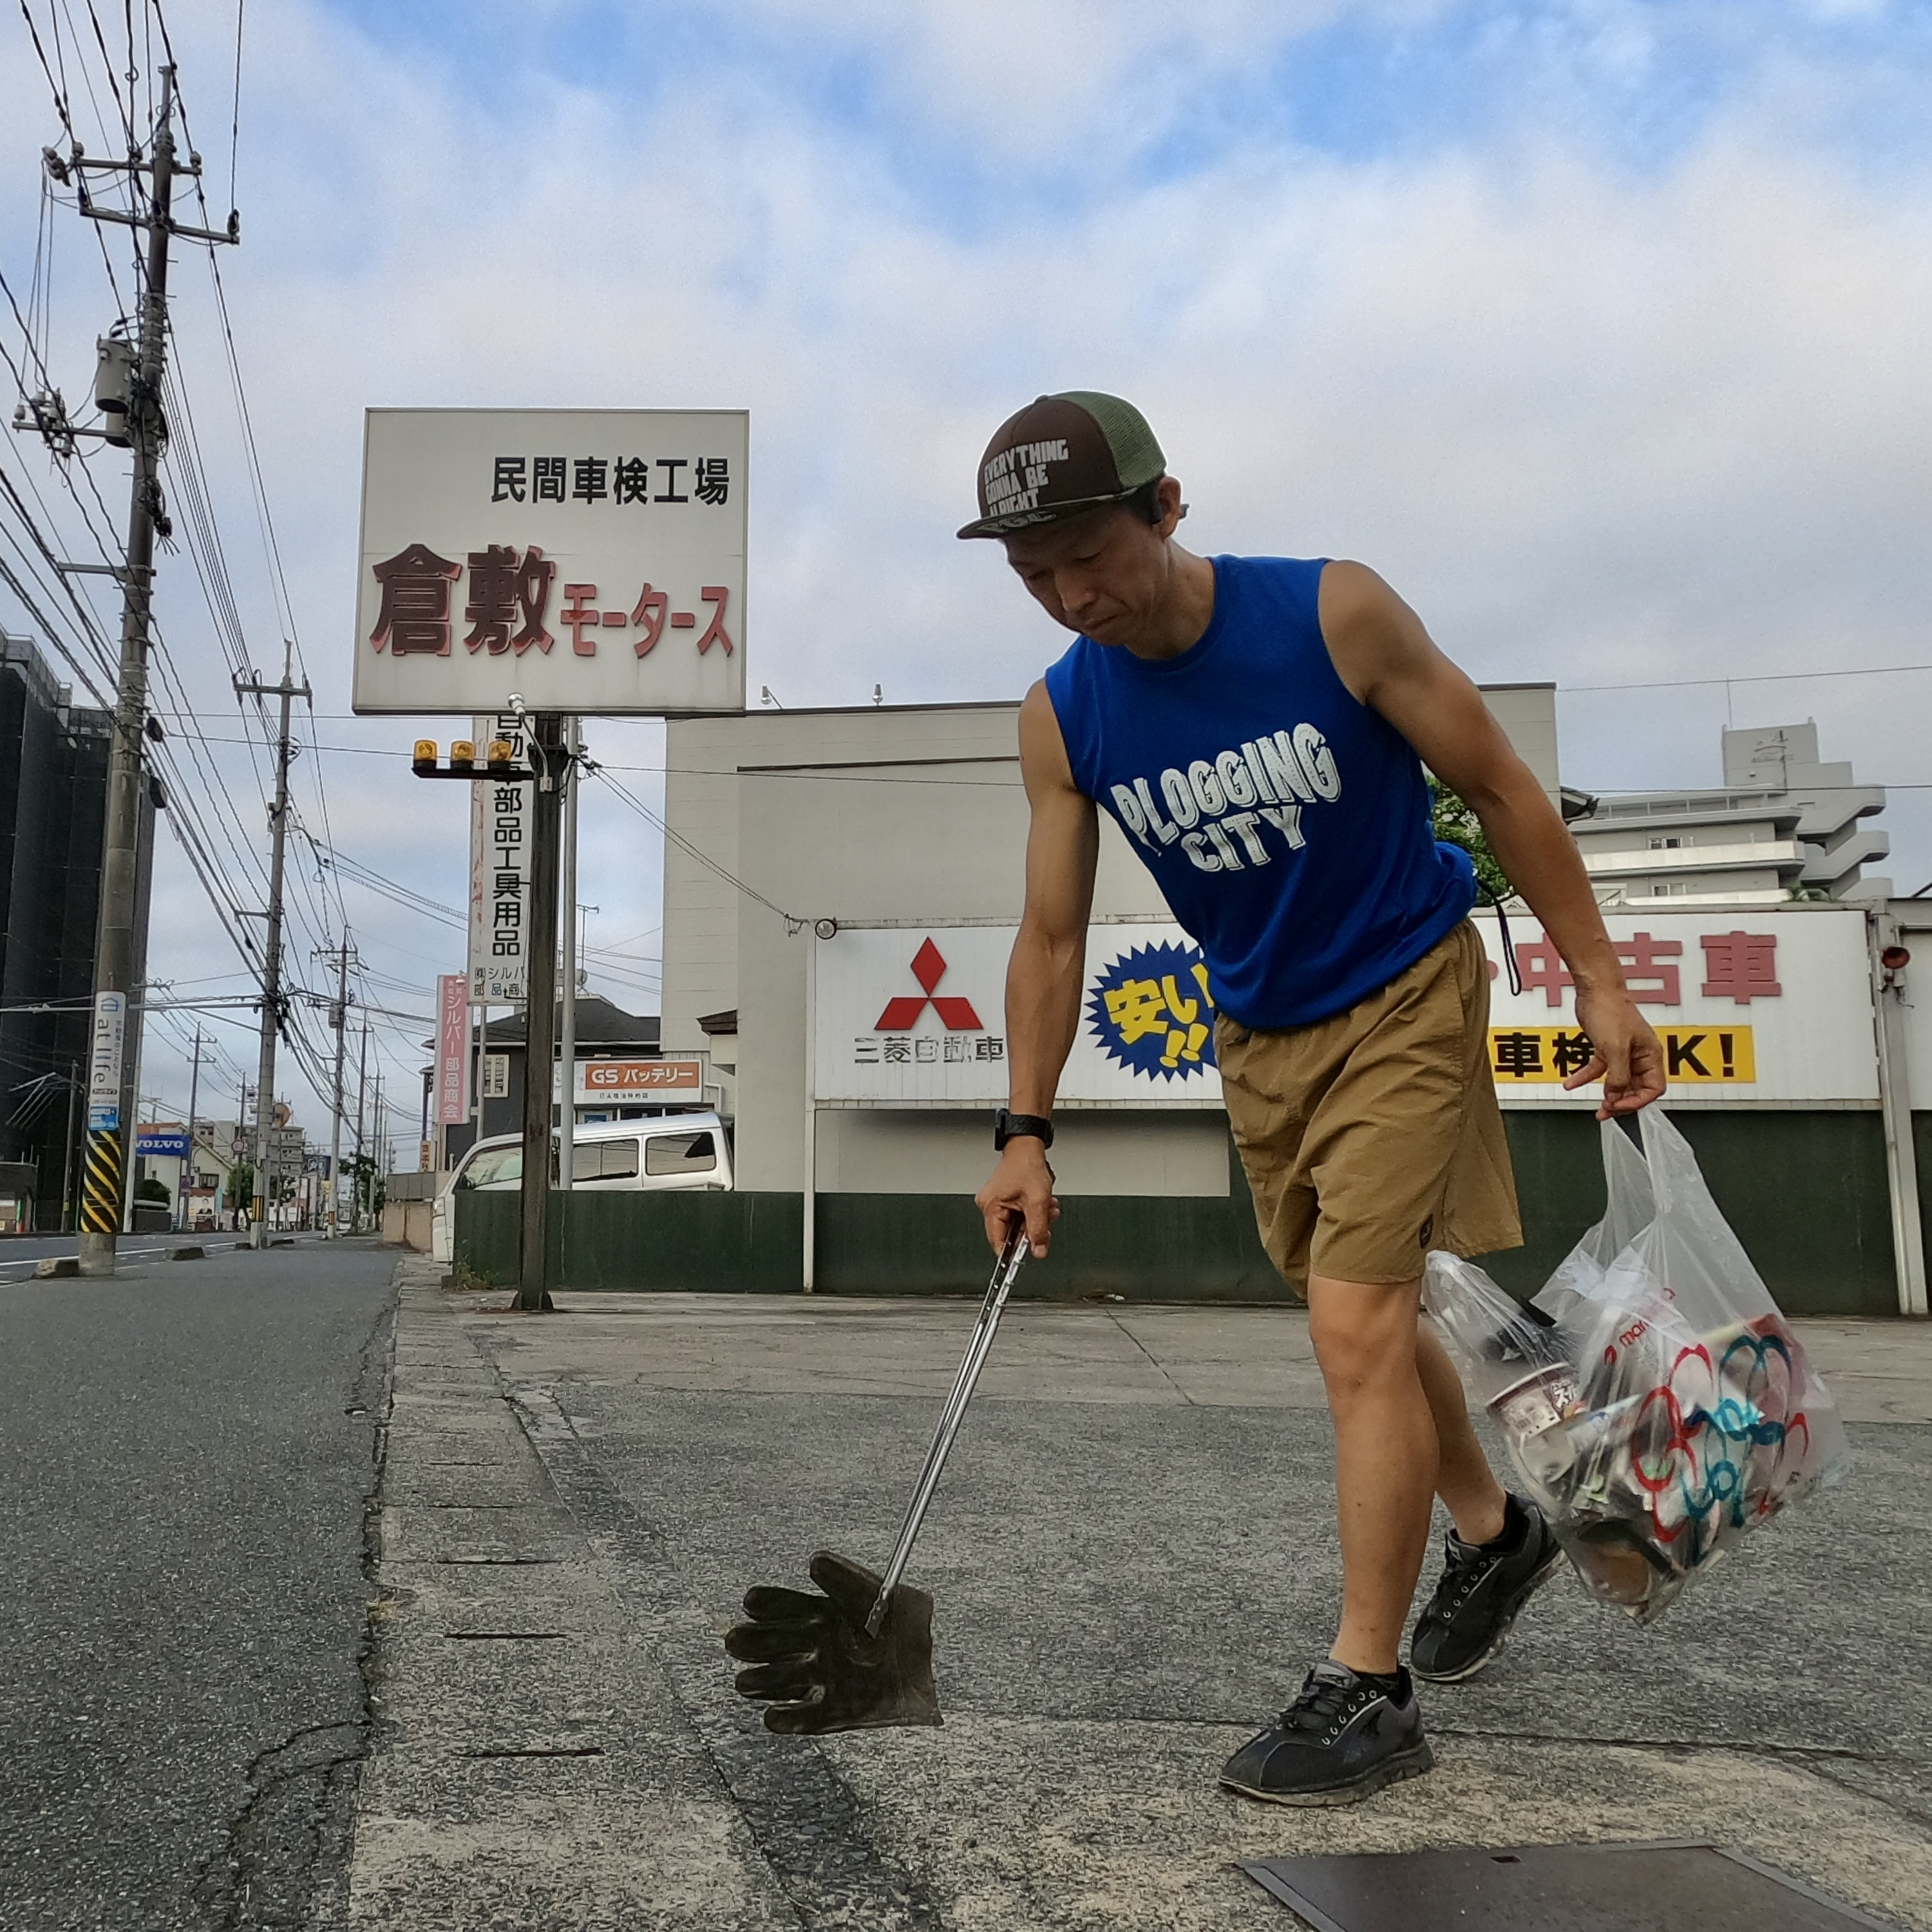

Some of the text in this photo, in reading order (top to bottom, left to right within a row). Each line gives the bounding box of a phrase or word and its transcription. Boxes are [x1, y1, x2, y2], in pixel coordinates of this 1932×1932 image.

[491, 456, 730, 506] 民間車検工場
[984, 439, 1069, 485] EVERYTHING
[985, 463, 1049, 505] GONNA BE
[368, 543, 734, 659] 倉敷モータース
[1110, 723, 1341, 858] PLOGGING
[492, 715, 522, 956] 自動部品工具用品
[1180, 805, 1307, 873] CITY
[853, 1036, 1004, 1065] 三菱自動車
[1494, 1032, 1735, 1077] 車検K!
[591, 1068, 618, 1084] GS
[623, 1067, 694, 1083] バッテリー
[136, 1139, 184, 1149] VOLVO
